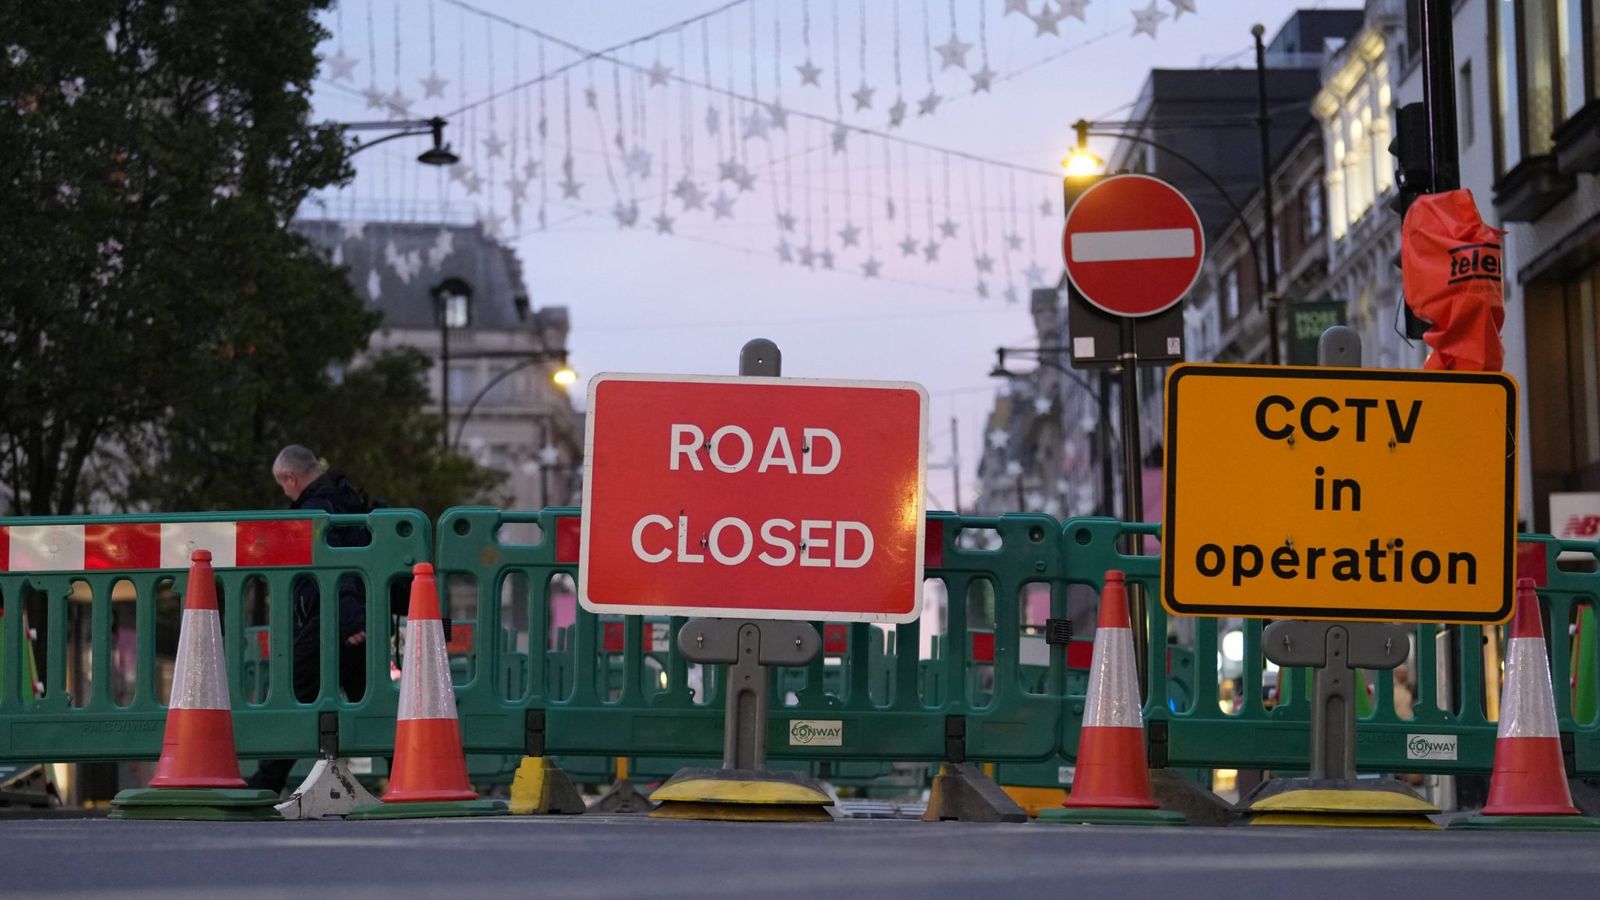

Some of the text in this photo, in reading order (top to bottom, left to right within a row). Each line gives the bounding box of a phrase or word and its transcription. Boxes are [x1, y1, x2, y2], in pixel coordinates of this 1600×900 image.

[1255, 394, 1423, 444] CCTV
[669, 423, 842, 475] ROAD
[1314, 466, 1361, 512] in
[631, 514, 874, 569] CLOSED
[1195, 538, 1477, 586] operation
[791, 727, 840, 737] CONWAY
[1408, 742, 1455, 752] CONWAY
